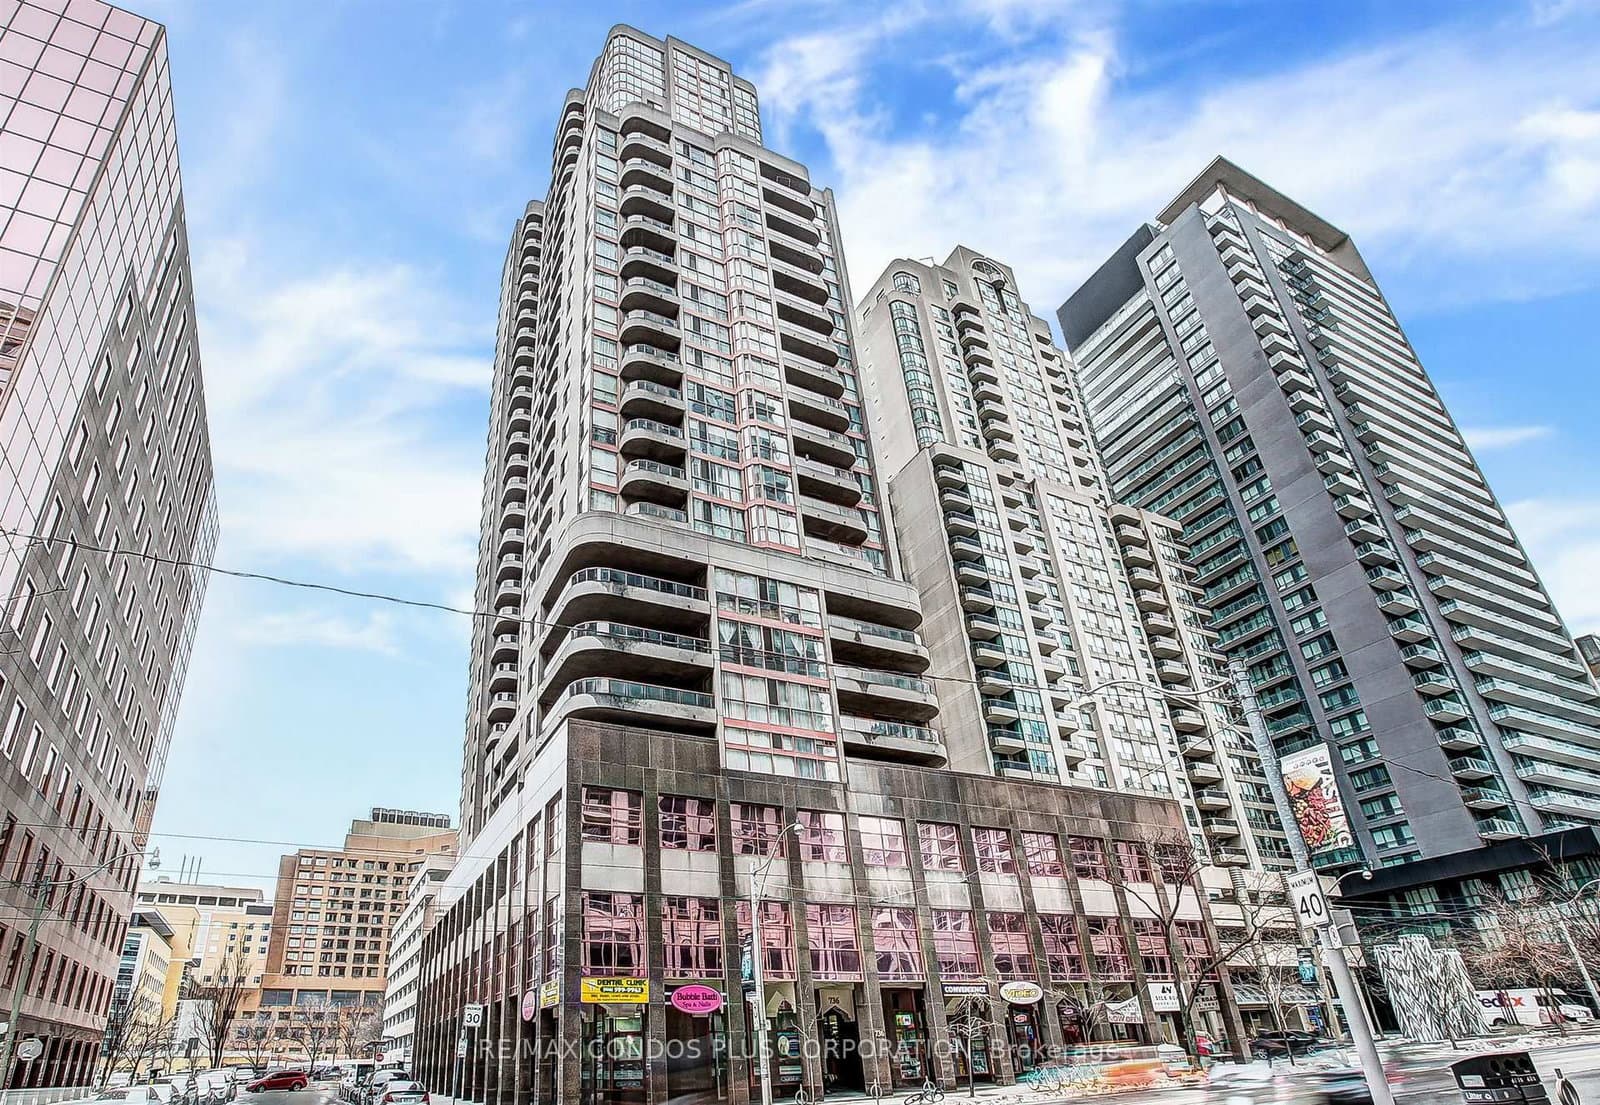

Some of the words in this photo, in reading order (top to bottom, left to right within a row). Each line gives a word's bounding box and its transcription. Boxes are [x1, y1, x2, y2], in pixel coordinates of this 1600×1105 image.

[1300, 892, 1323, 919] 40
[944, 985, 986, 994] CONVENIENCE
[677, 992, 701, 1001] Bubble
[828, 996, 840, 1005] 736
[466, 1013, 481, 1024] 30
[1465, 1091, 1482, 1100] Litter
